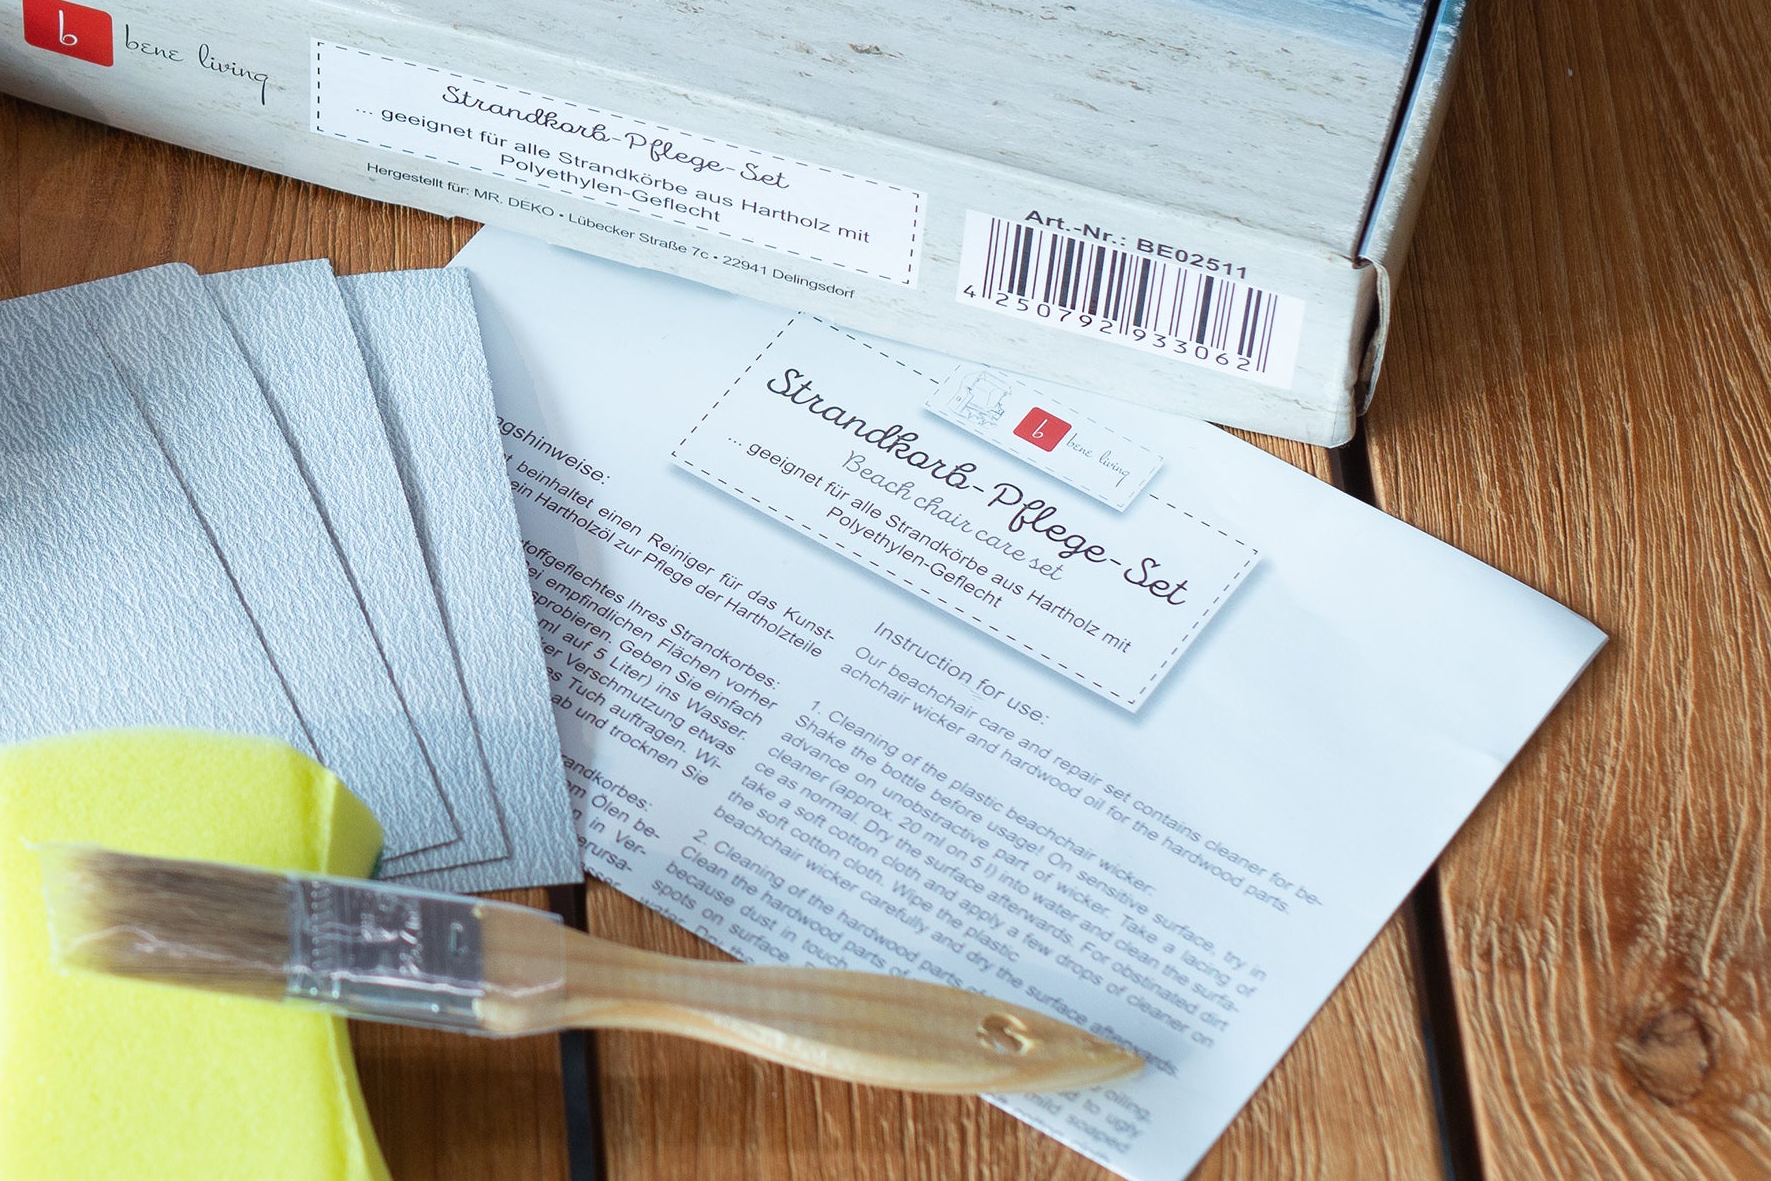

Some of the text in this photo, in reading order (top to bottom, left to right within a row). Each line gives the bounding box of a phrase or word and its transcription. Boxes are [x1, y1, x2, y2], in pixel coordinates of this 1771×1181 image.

[125, 23, 269, 106] bene living
[381, 109, 869, 243] geeignet für alle Strandkörbe aus Hartholz mit
[442, 85, 790, 189] Strandkorb-Pflege-Set
[500, 153, 720, 223] Polyethylen-Geflecht
[367, 162, 855, 299] Hergestellt für: MR. DEKO Lübecker Straße 7c 22941 Delingsdorf
[1024, 210, 1246, 279] Art.-Nr.: BE02511
[766, 368, 1188, 606] Strandkorb-Pflege-Set
[841, 449, 1064, 581] Beach chair care set
[515, 460, 835, 640] beinhaltet einen Reiniger für das Kunst-
[534, 491, 616, 543] Hartholzöl
[613, 538, 643, 557] zur
[642, 552, 694, 587] Pflege
[695, 584, 724, 603] der
[723, 597, 822, 657] Hartholzteile
[746, 443, 1131, 653] geeignet für alle Strandkörbe aus Hartholz mit
[826, 506, 1003, 608] Polyethylen-Geflecht
[522, 539, 780, 690] toffgeflechtes Ihres Strandkorbes:
[545, 578, 778, 709] empfindlichen Flächen vorher
[562, 632, 594, 652] auf
[593, 647, 609, 660] 5
[609, 655, 653, 688] Liter)
[655, 681, 681, 702] ins
[686, 697, 748, 741] Wasser.
[566, 652, 737, 756] Verschmutzung etwas
[568, 676, 722, 769] Tuch auftragen. Wi-
[619, 639, 672, 675] Geben
[674, 670, 702, 692] Sie
[704, 689, 763, 726] einfach
[855, 646, 1131, 803] Our beachchair care and repair set
[873, 621, 1050, 725] Instruction for use:
[575, 707, 609, 730] und
[609, 724, 679, 770] trocknen
[681, 764, 709, 786] Sie
[794, 714, 1045, 856] Shake the bottle before usage!
[811, 700, 1004, 812] 1. Cleaning of the plastic
[840, 663, 1084, 798] achchair wicker and hardwood
[590, 816, 647, 855] in Ver-
[592, 794, 660, 839] Ölen be-
